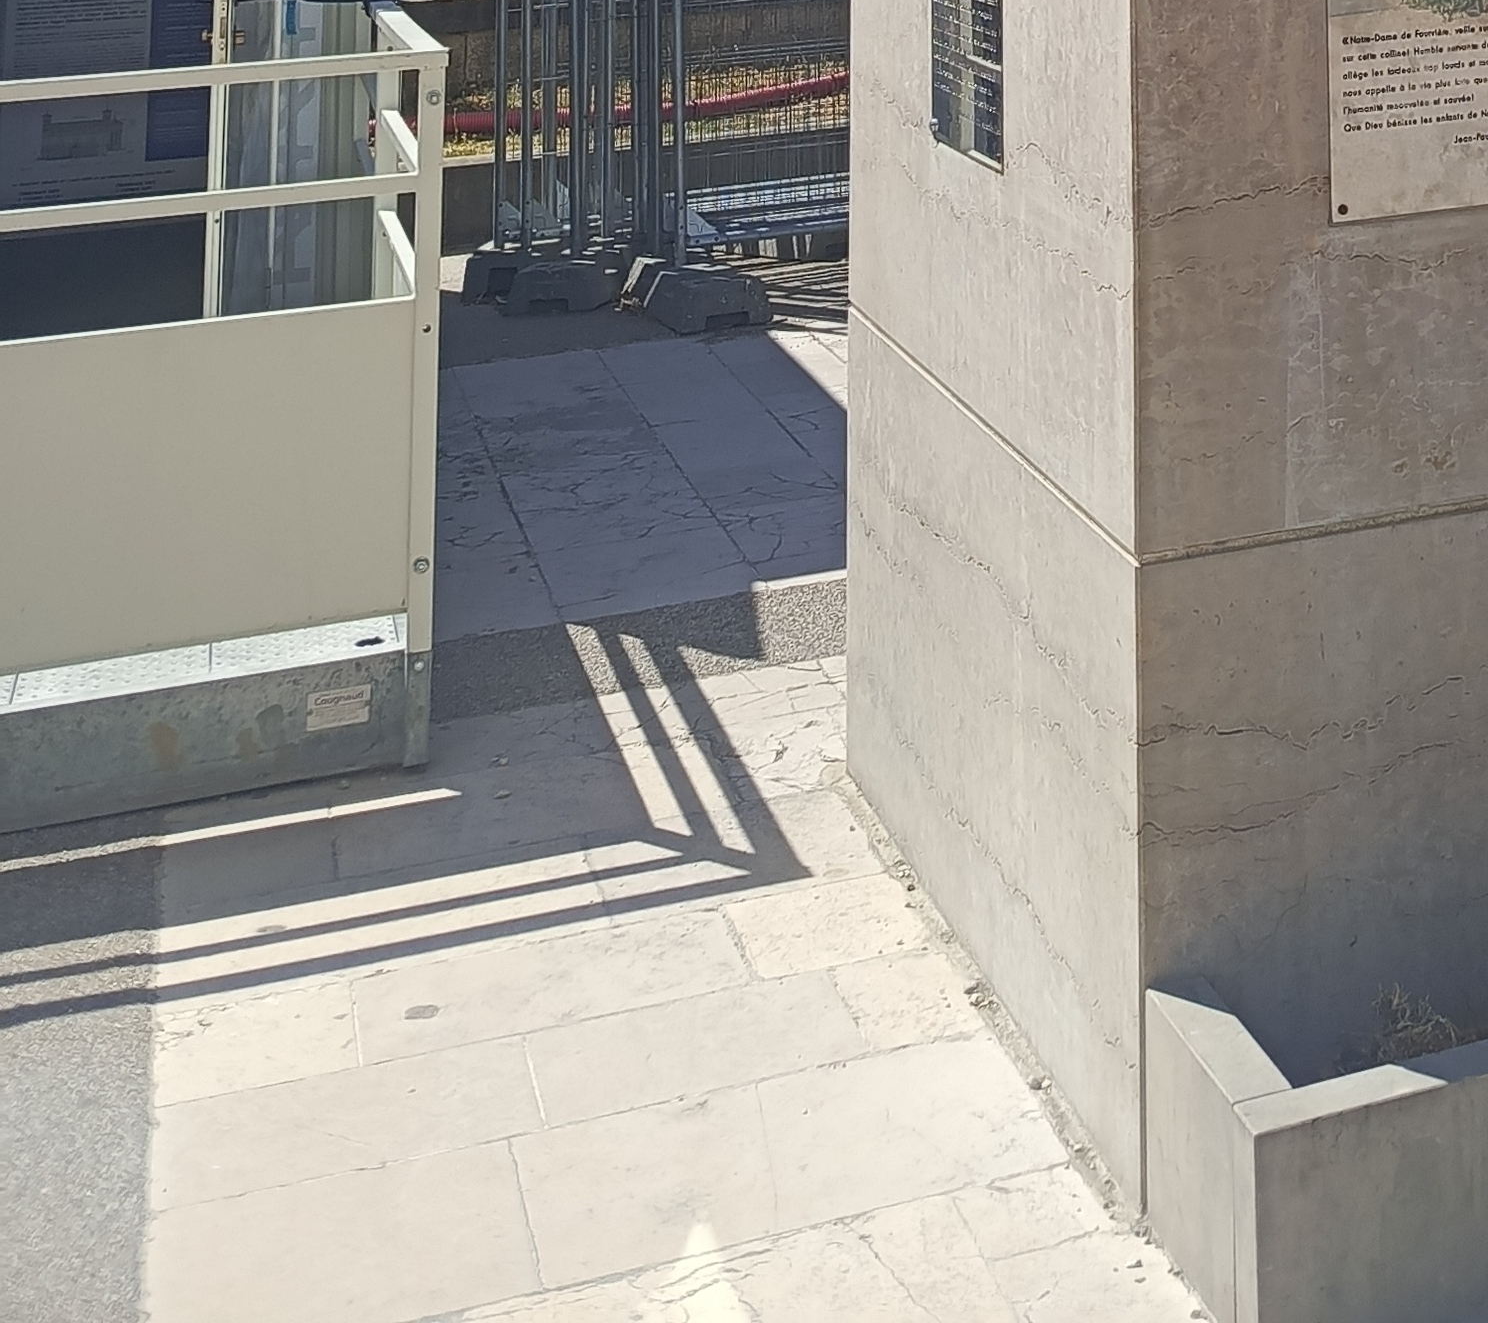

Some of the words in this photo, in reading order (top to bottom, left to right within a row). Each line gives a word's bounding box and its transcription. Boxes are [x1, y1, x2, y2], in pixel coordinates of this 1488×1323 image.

[1401, 30, 1411, 39] de
[1455, 25, 1475, 34] veille
[1343, 55, 1354, 63] sur
[1358, 53, 1377, 61] cette
[1414, 45, 1443, 56] Humble
[1447, 43, 1478, 53] servante
[1343, 70, 1368, 81] allège
[1372, 68, 1384, 77] les
[1442, 61, 1465, 70] lourds
[1469, 60, 1476, 68] et
[1343, 90, 1362, 98] nous
[1365, 85, 1396, 97] appelle
[1400, 83, 1405, 91] à
[1408, 82, 1416, 91] la
[1420, 81, 1432, 90] vie
[1435, 79, 1451, 90] plus
[1474, 76, 1488, 85] que
[1386, 99, 1429, 110] renouvelée
[1433, 98, 1440, 106] et
[1343, 123, 1361, 133] Que
[1365, 121, 1383, 131] Dieu
[1386, 118, 1418, 129] bénisse
[1421, 116, 1433, 125] les
[1436, 113, 1464, 123] enfants
[1467, 110, 1478, 119] de
